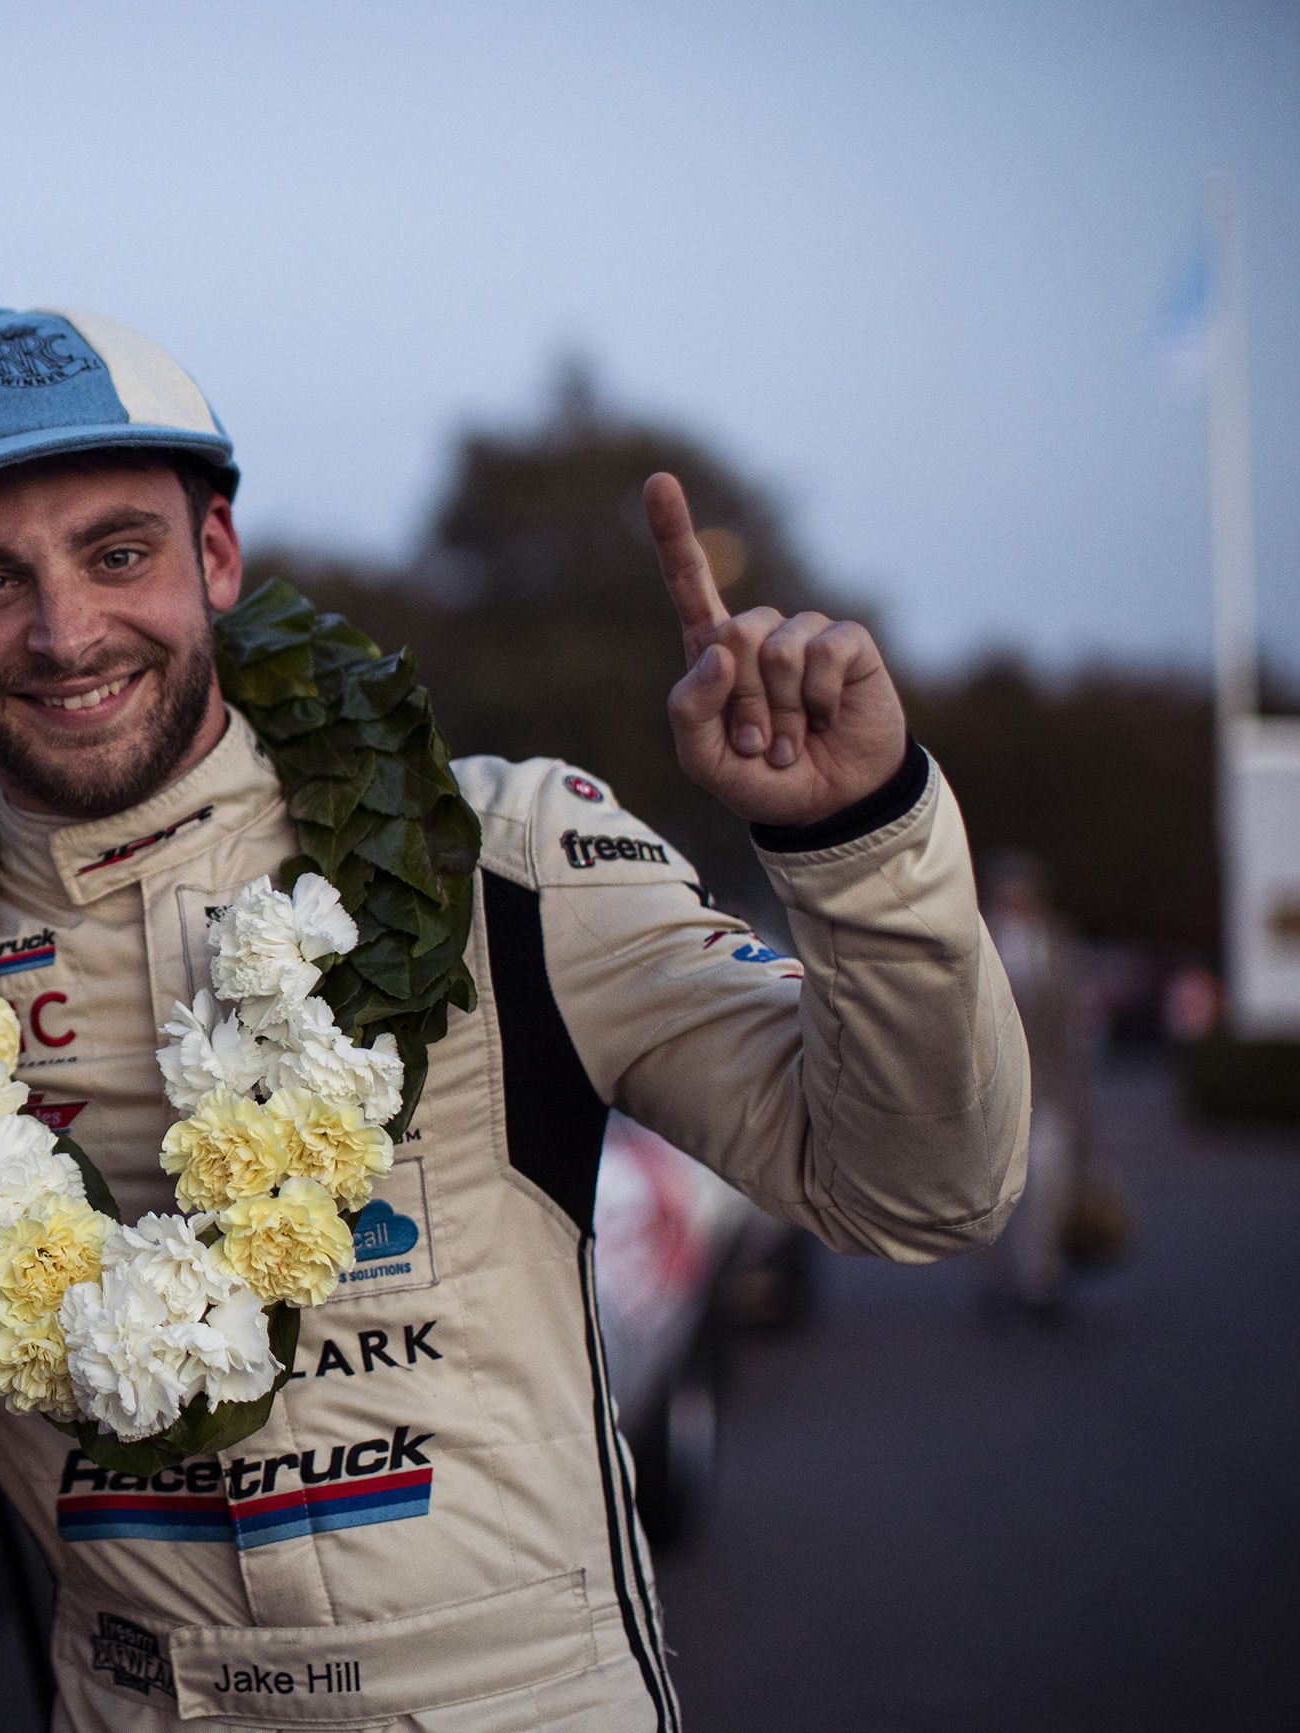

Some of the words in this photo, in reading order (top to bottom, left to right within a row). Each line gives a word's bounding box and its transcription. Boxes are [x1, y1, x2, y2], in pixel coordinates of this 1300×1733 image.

[1, 371, 69, 388] WINNER
[560, 830, 670, 867] freem
[353, 1222, 390, 1249] call
[350, 1262, 412, 1283] SOLUTIONS
[58, 1425, 435, 1500] Racetruck
[214, 1664, 295, 1695] Jake
[306, 1660, 362, 1694] Hill
